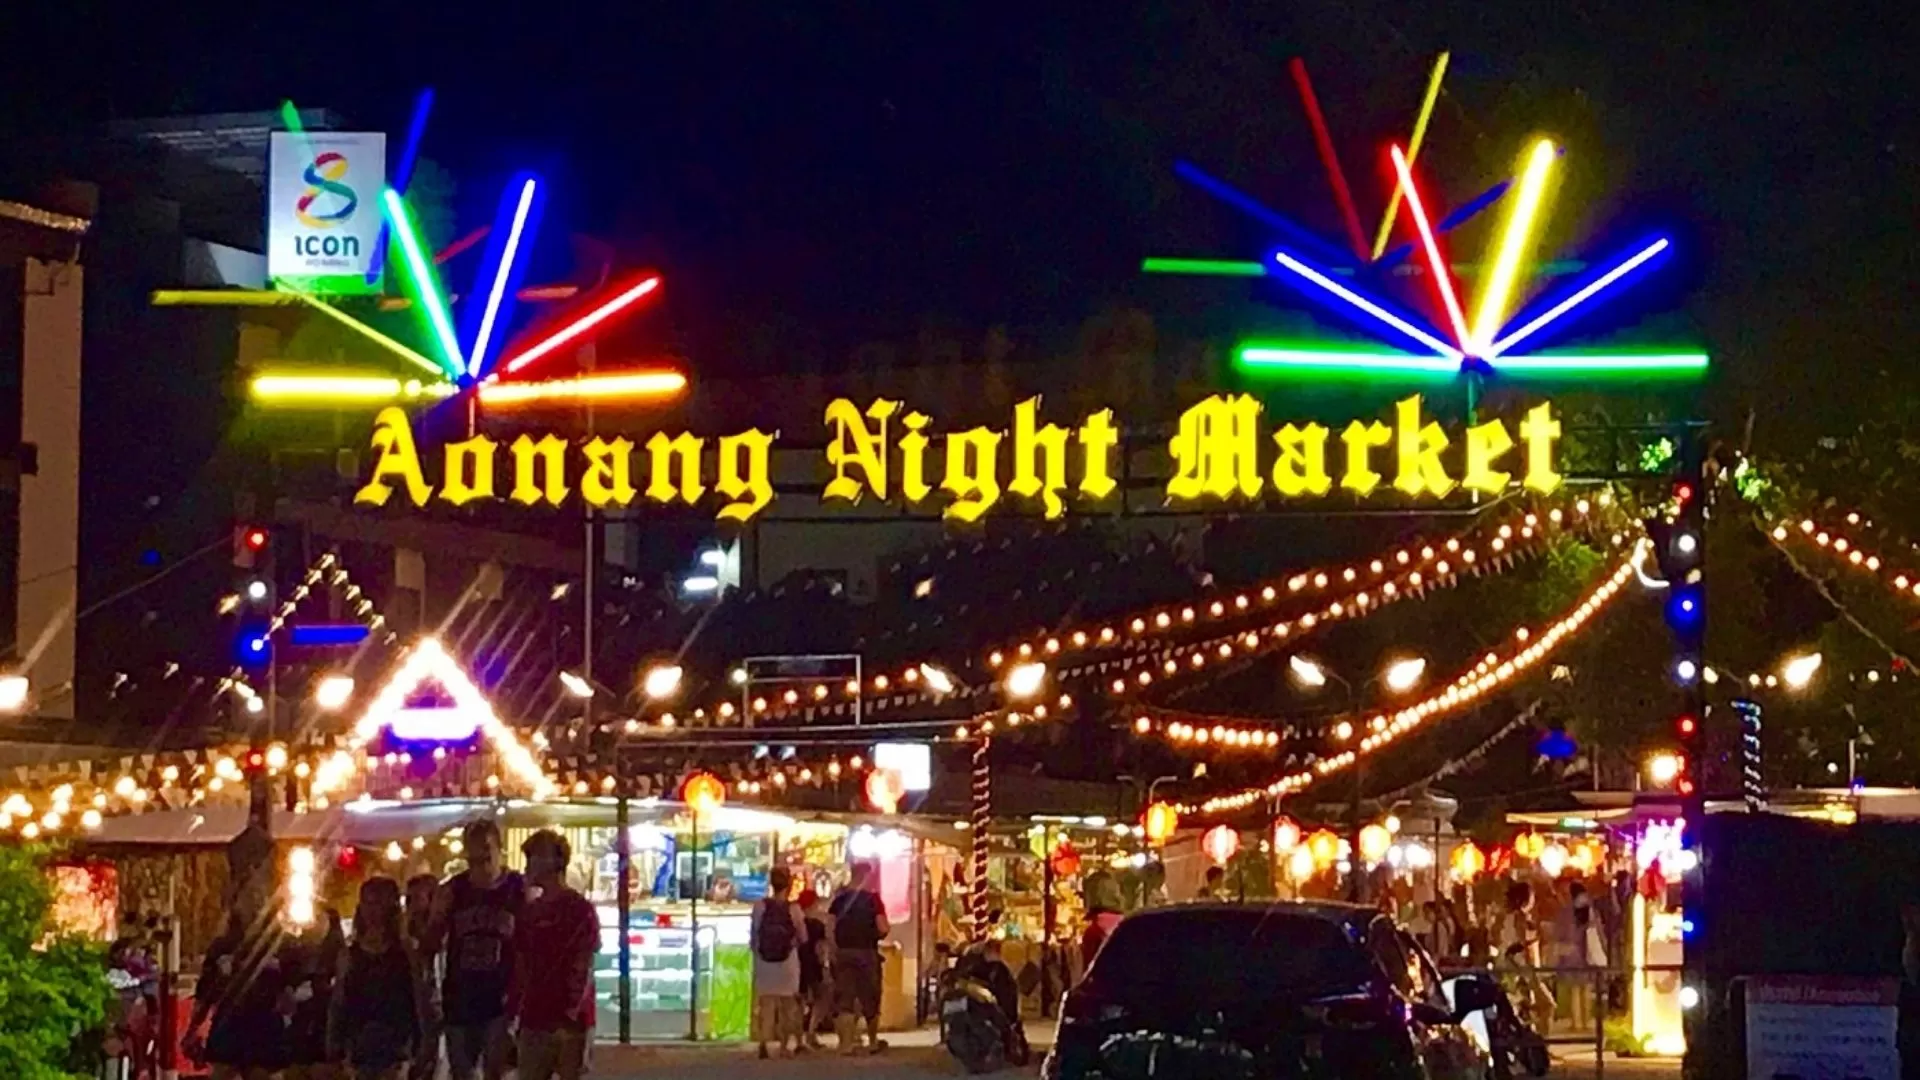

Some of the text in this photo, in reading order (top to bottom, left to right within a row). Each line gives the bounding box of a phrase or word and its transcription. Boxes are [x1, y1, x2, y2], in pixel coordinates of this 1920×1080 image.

[294, 235, 360, 257] icon
[353, 394, 1563, 522] Aonang Night Market
